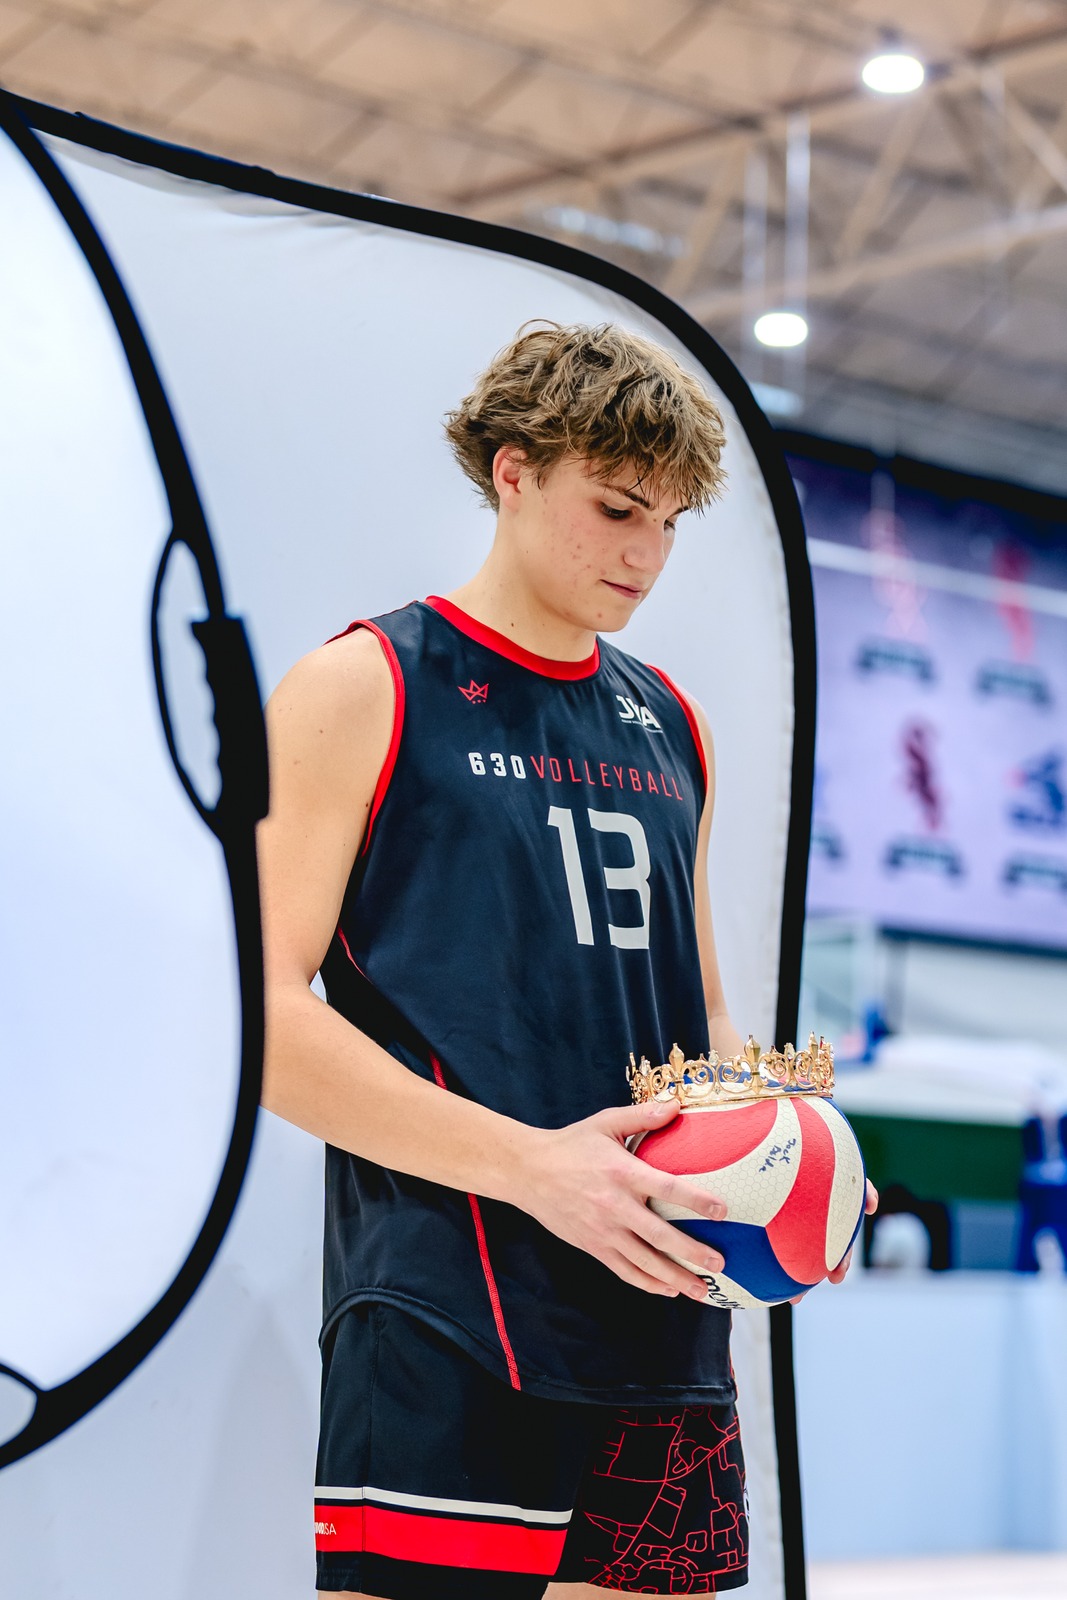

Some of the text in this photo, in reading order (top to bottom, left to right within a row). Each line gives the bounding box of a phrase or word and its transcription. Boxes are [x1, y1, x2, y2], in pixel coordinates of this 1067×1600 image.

[468, 752, 683, 801] 630 VOLLEYBALL
[547, 805, 651, 950] 13
